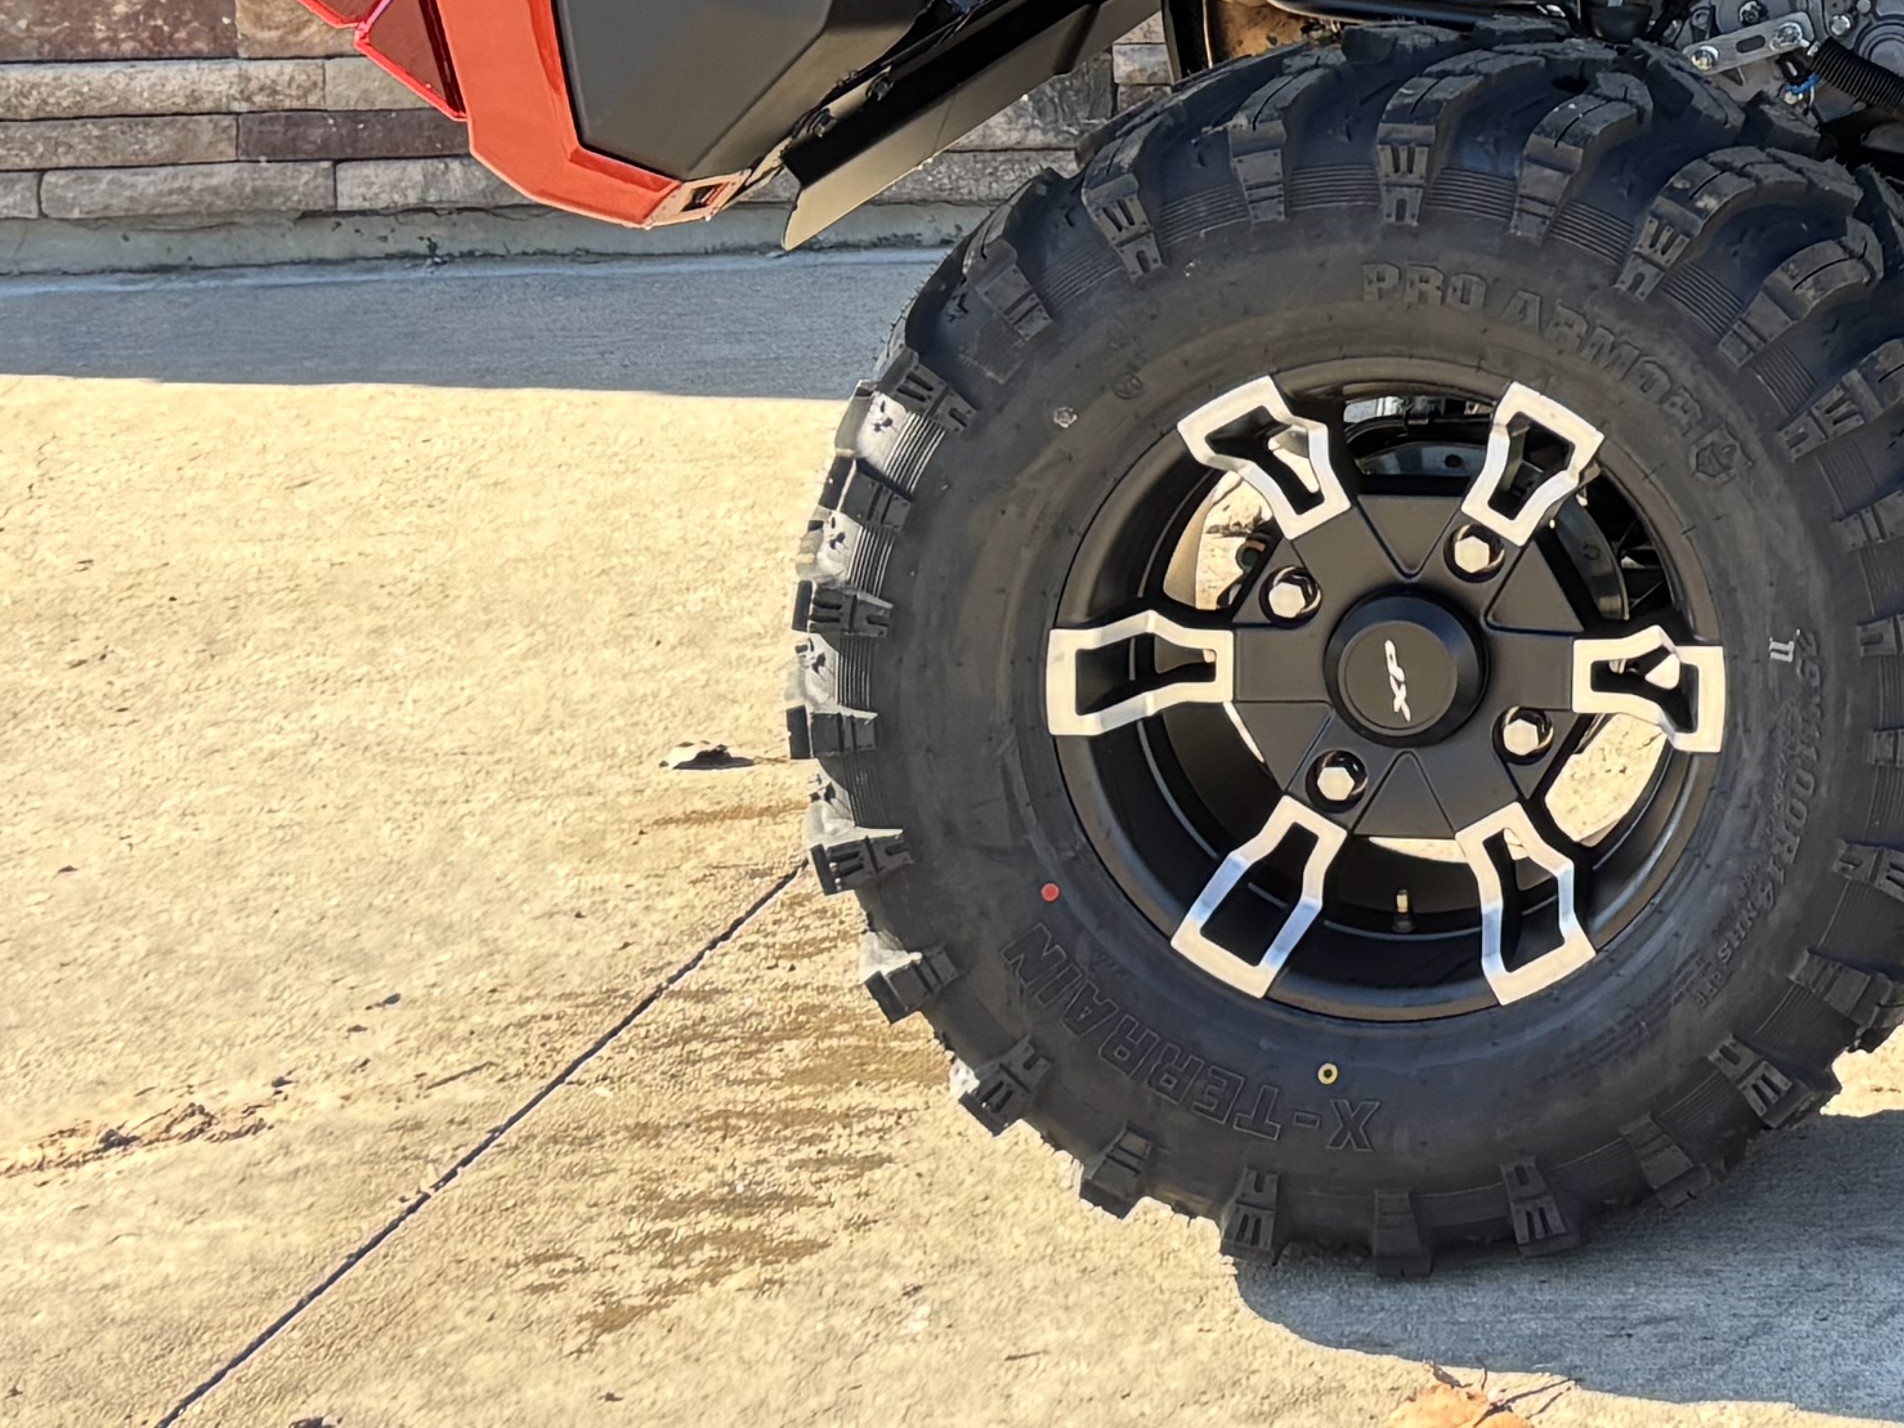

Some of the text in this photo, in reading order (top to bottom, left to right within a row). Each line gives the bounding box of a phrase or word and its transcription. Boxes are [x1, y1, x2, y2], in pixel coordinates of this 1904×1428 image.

[1361, 261, 1707, 437] PRO ARMOR
[1384, 637, 1411, 722] XP
[1001, 921, 1381, 1152] X-TERRAIN
